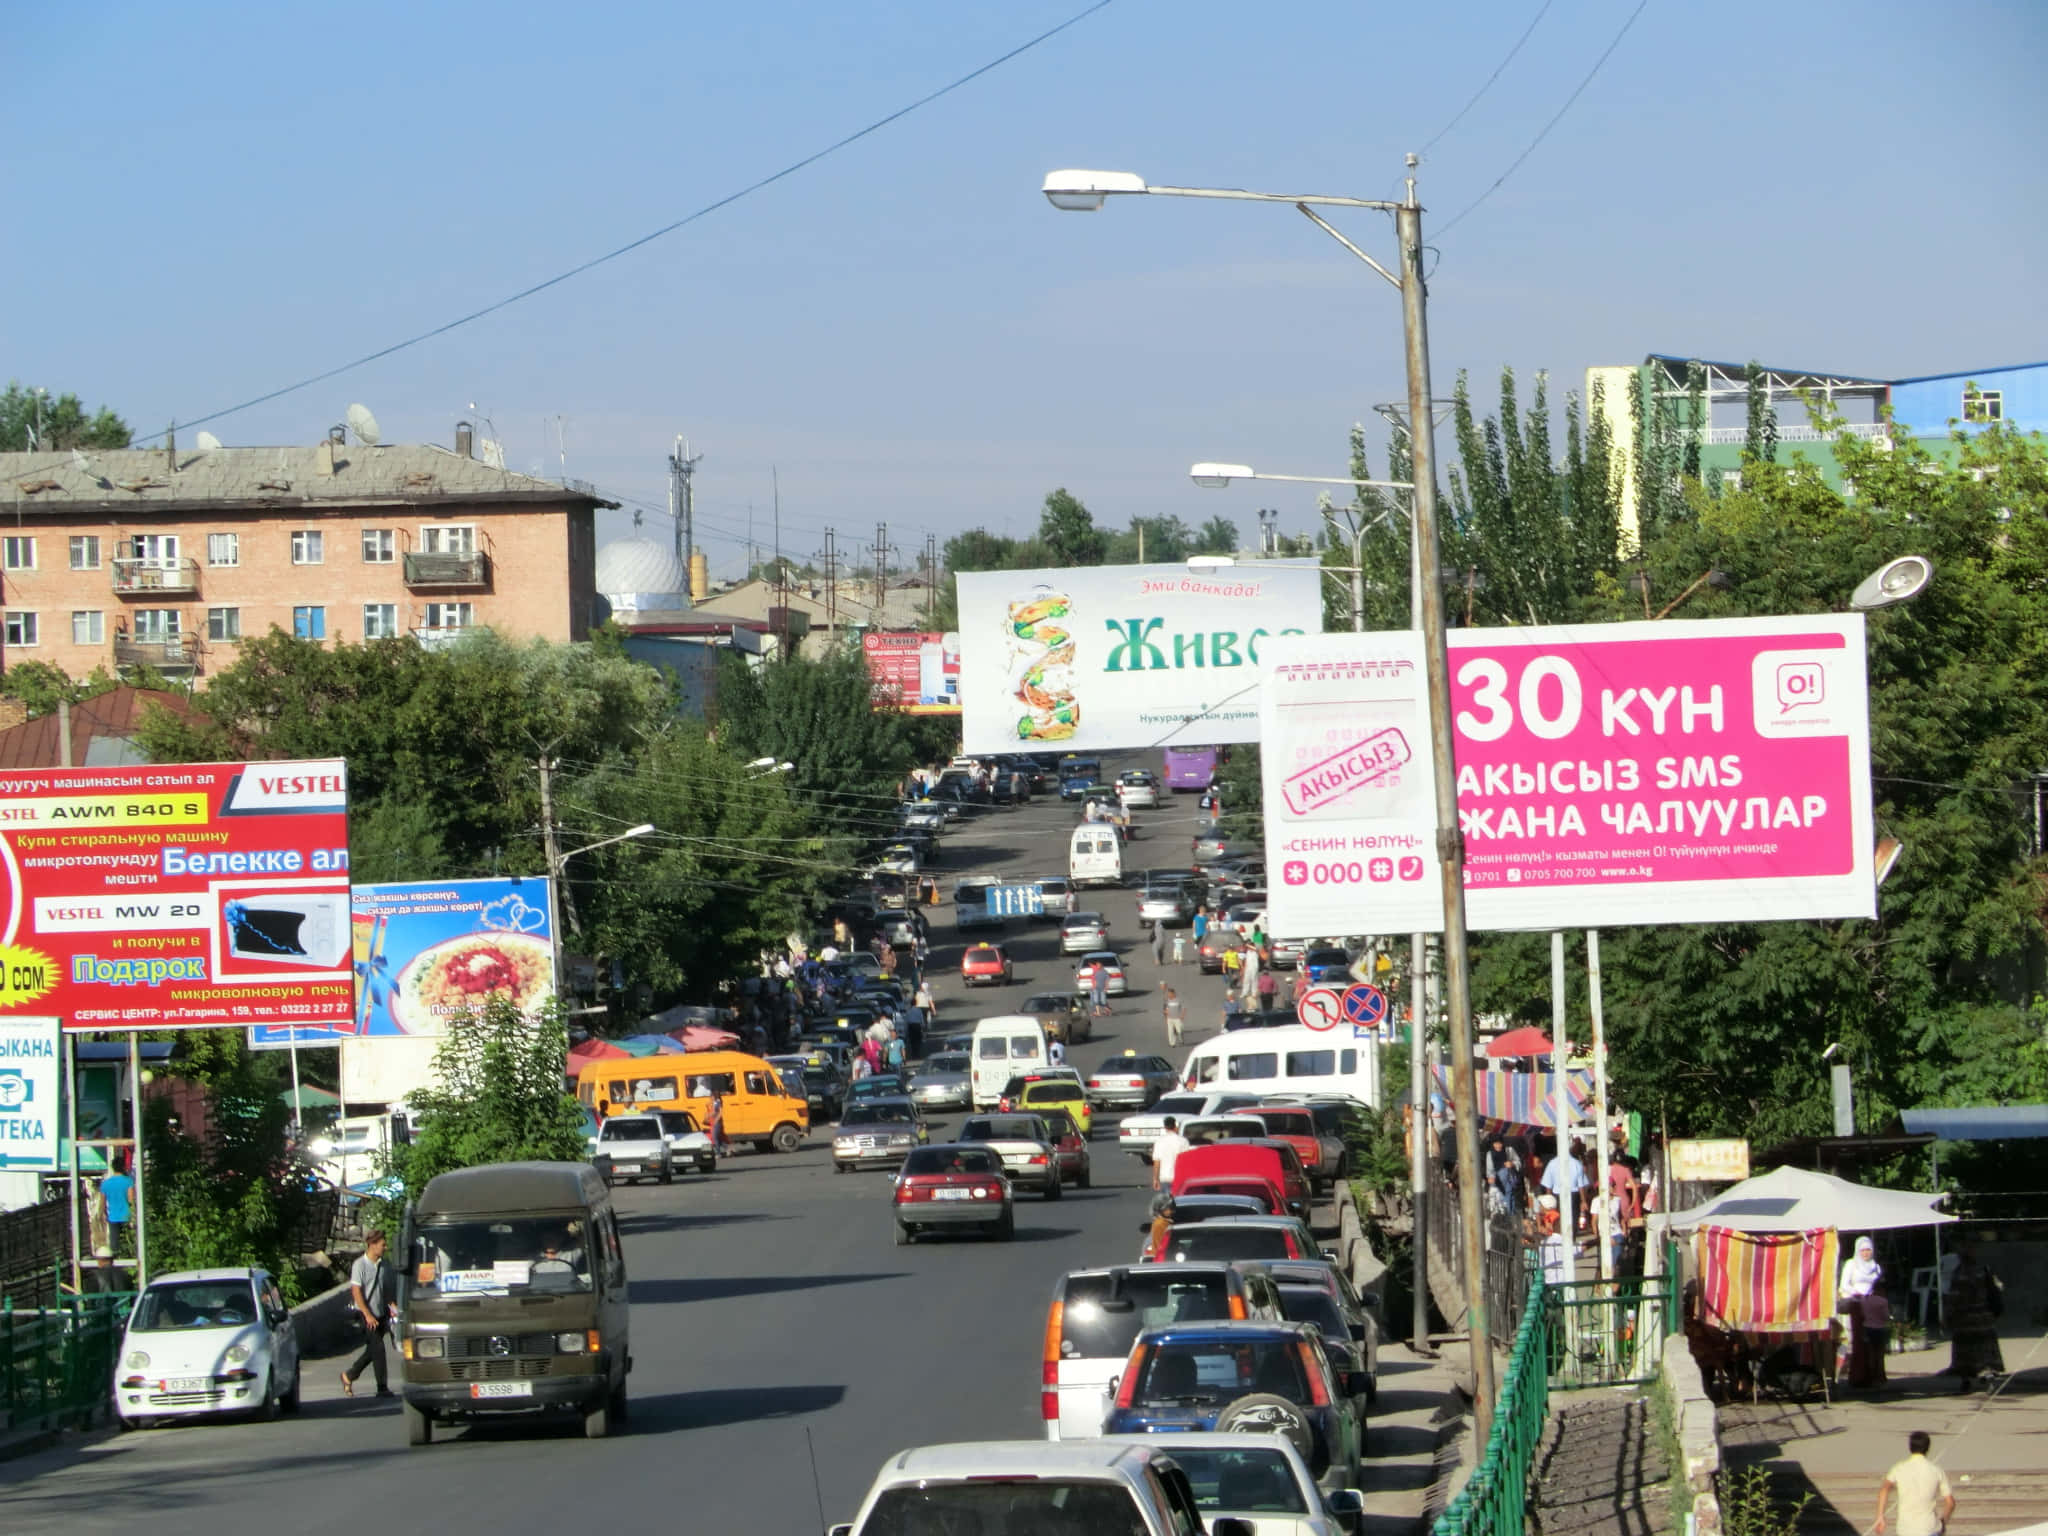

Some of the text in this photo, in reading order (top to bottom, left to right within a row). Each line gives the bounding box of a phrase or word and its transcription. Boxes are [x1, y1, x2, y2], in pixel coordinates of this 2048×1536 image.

[1141, 579, 1261, 597] Эми банкада!
[1103, 617, 1304, 672] Жив
[1787, 674, 1815, 694] O!
[1456, 655, 1725, 742] 30 КҮН
[1300, 741, 1395, 802] АКЫСЫЗ
[1456, 755, 1743, 796] АКЫСЫЗ SMS
[54, 775, 142, 788] машинасын
[146, 774, 192, 786] сатып
[196, 774, 215, 784] ал
[259, 775, 345, 794] VESTEL
[52, 805, 115, 819] AWM
[126, 804, 173, 817] 840
[184, 803, 198, 815] S
[1459, 796, 1827, 840] ЖАНА ЧАЛУУЛАР
[17, 831, 229, 849] Купи стиральную машину
[1282, 837, 1346, 852] «СЕНИН
[163, 847, 302, 874] Белекке
[1556, 849, 1608, 861] кызматы
[1612, 849, 1650, 859] менен
[1734, 843, 1778, 854] ичинде
[25, 854, 159, 870] микротолкундуу
[105, 873, 158, 885] мешти
[1474, 866, 1653, 882] 0701 0705 700 700 www.o.kg
[47, 905, 201, 920] VESTEL MW 20
[113, 936, 200, 950] и получи в
[73, 955, 204, 986] Подарок
[171, 984, 349, 1001] микроволновую печь
[75, 1009, 119, 1020] СЕРВИС
[122, 1008, 160, 1020] ЦЕНТР:
[281, 1004, 311, 1015] 03222
[313, 1004, 320, 1014] 2
[322, 1003, 333, 1014] 27
